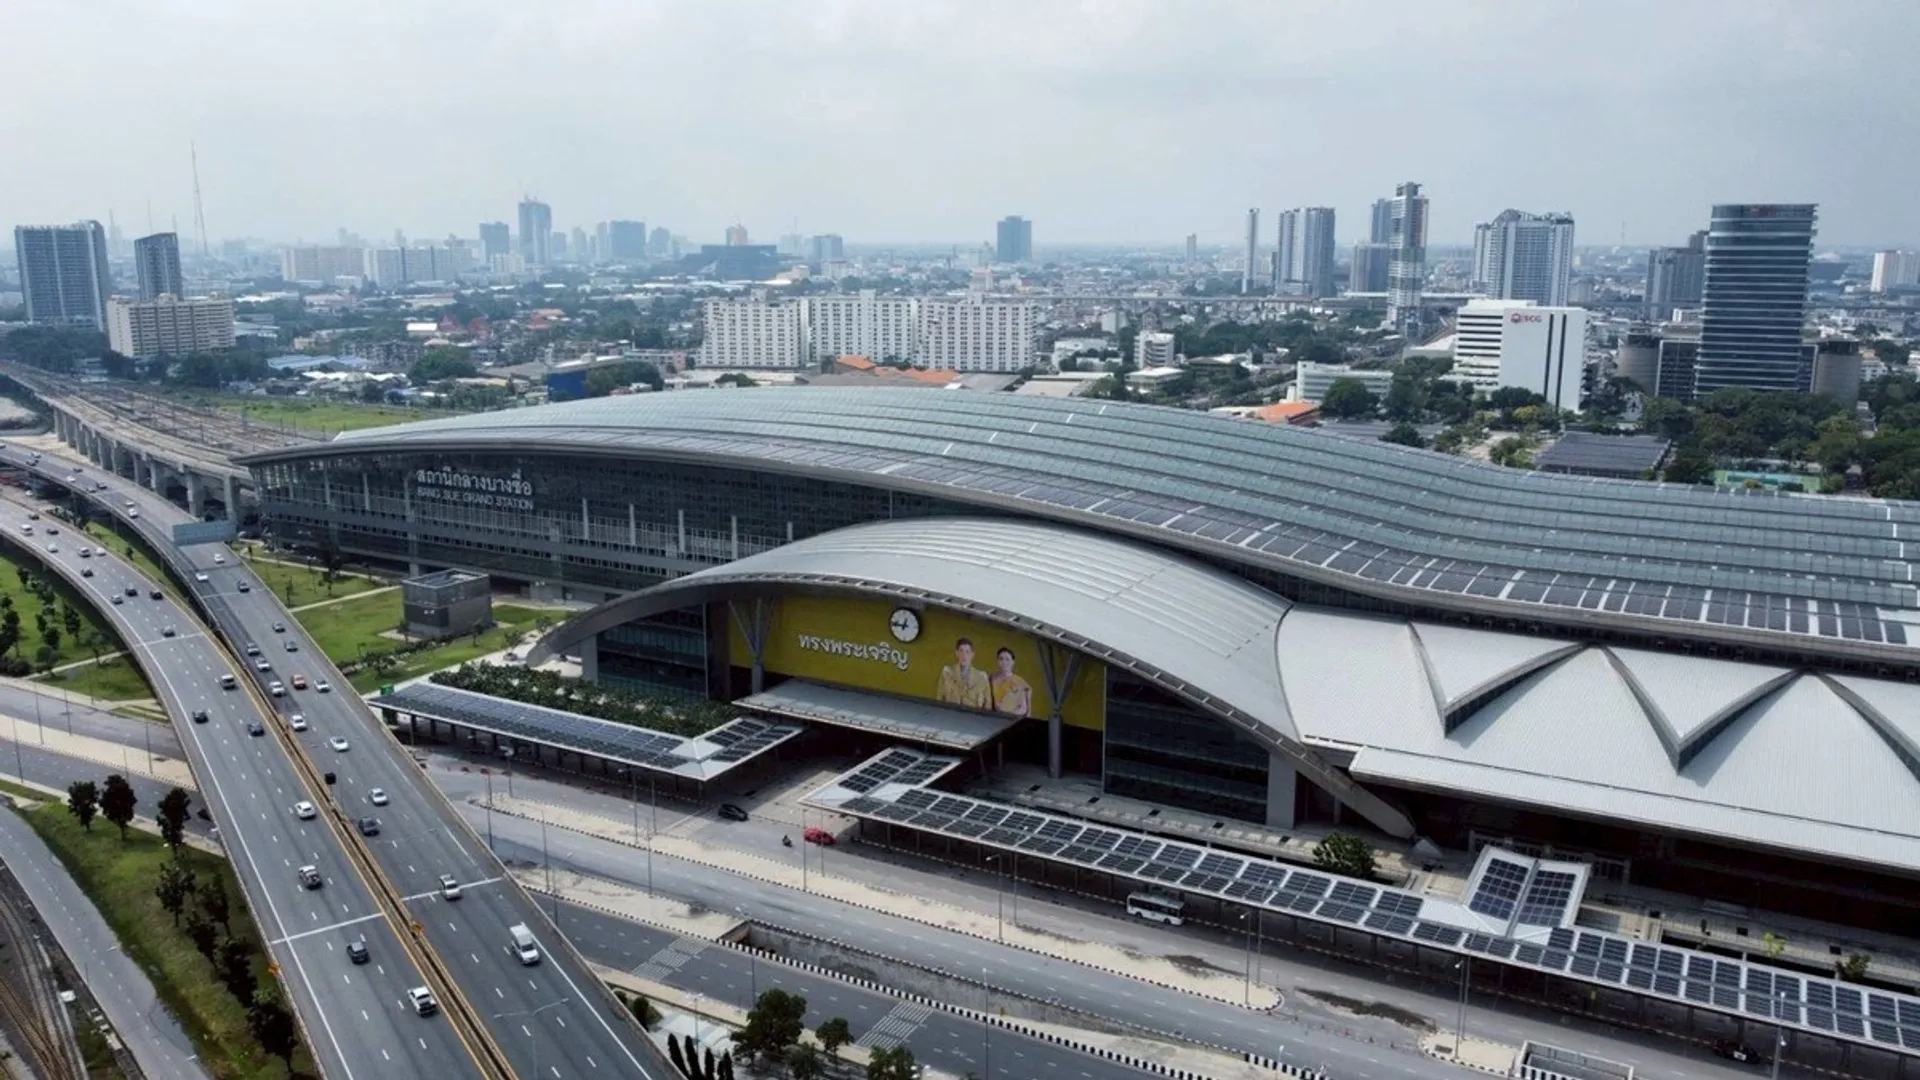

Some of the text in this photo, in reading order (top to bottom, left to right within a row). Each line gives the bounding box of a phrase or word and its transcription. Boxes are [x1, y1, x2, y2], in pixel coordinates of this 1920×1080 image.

[416, 465, 532, 496] สถานีกลางบางซื่อ
[417, 486, 534, 510] BANG SUE GRAND STATION
[798, 634, 909, 671] ทรงพระเจริญ
